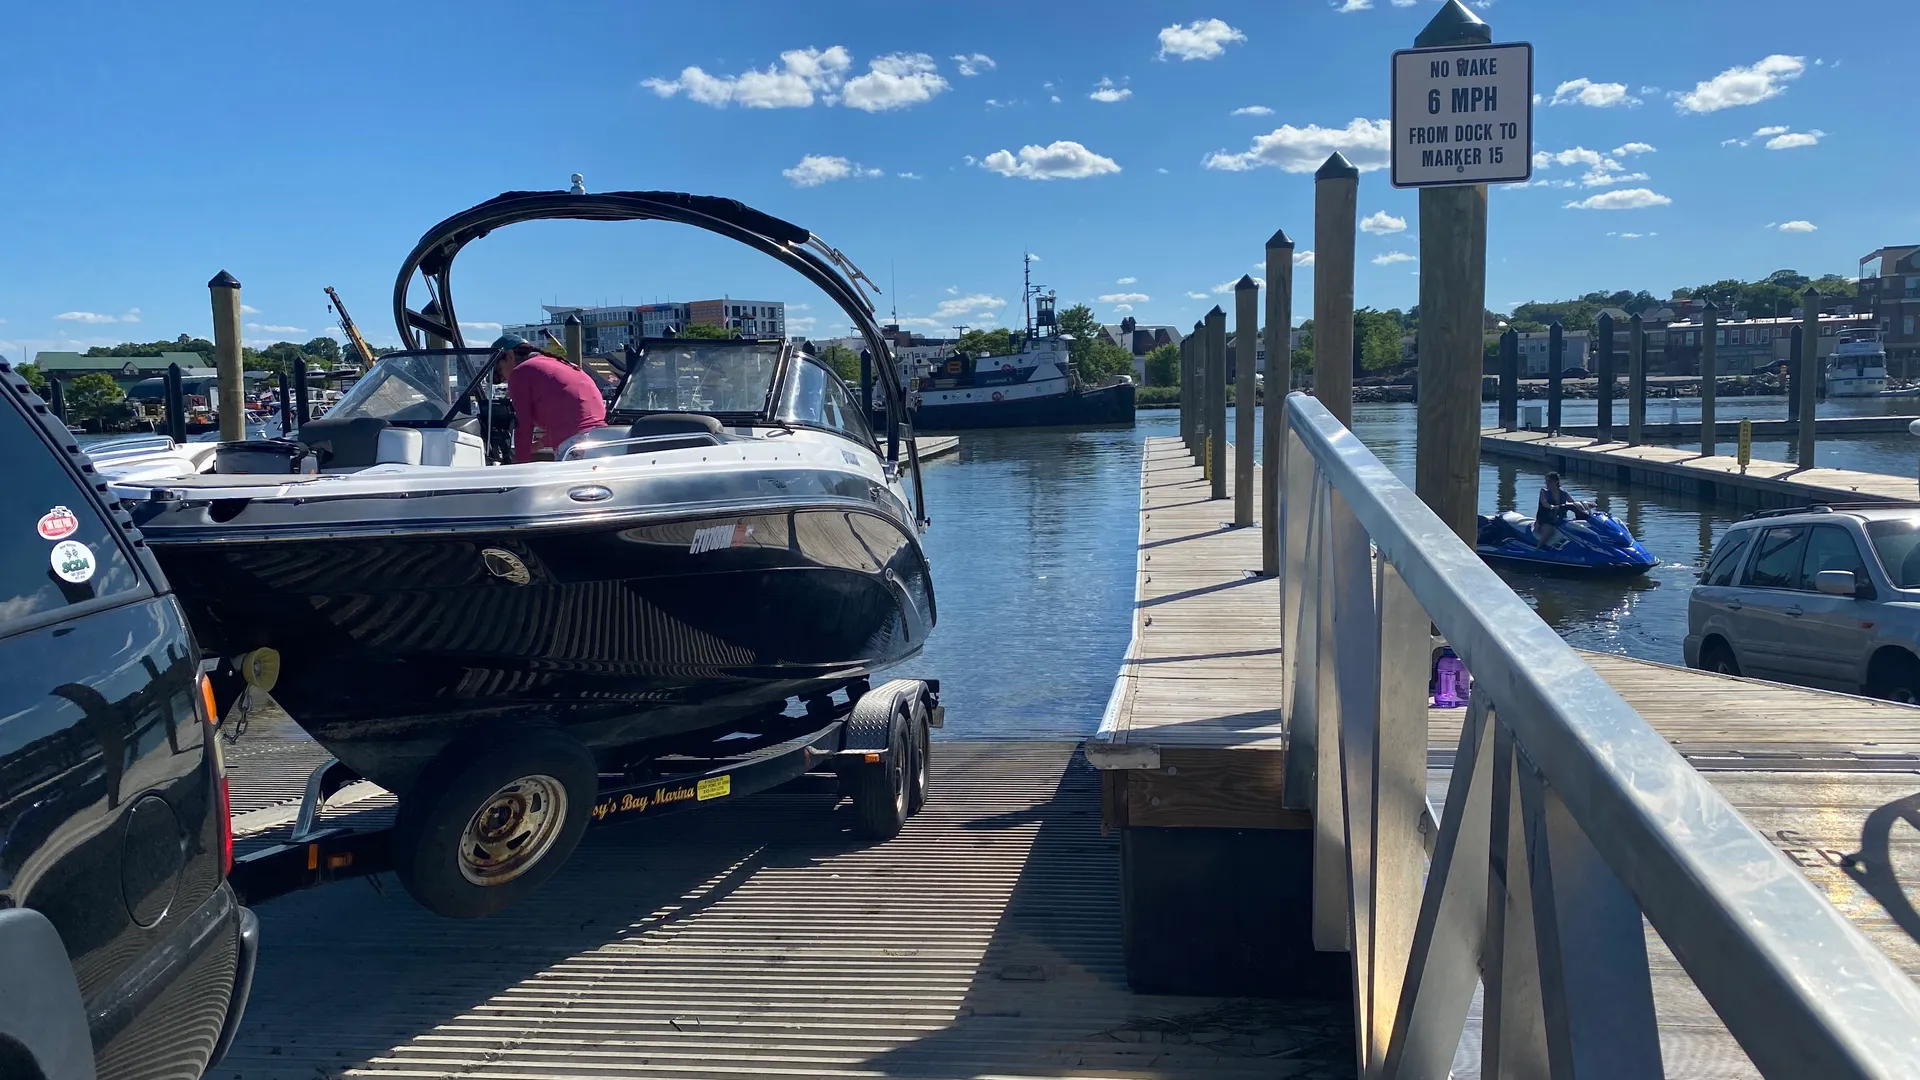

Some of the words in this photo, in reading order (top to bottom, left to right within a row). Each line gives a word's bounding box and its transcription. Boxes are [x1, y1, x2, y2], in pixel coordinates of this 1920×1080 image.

[1430, 60, 1450, 78] NO
[1456, 57, 1498, 77] WAKE
[1428, 88, 1441, 115] 6
[1451, 85, 1498, 113] MPH
[1409, 125, 1449, 145] FROM
[1455, 123, 1493, 142] DOCK
[1499, 121, 1518, 140] TO
[1422, 147, 1482, 167] MARKER
[1488, 146, 1504, 164] 15
[592, 796, 618, 820] sy's
[620, 793, 649, 812] Bay
[651, 785, 696, 805] Marina
